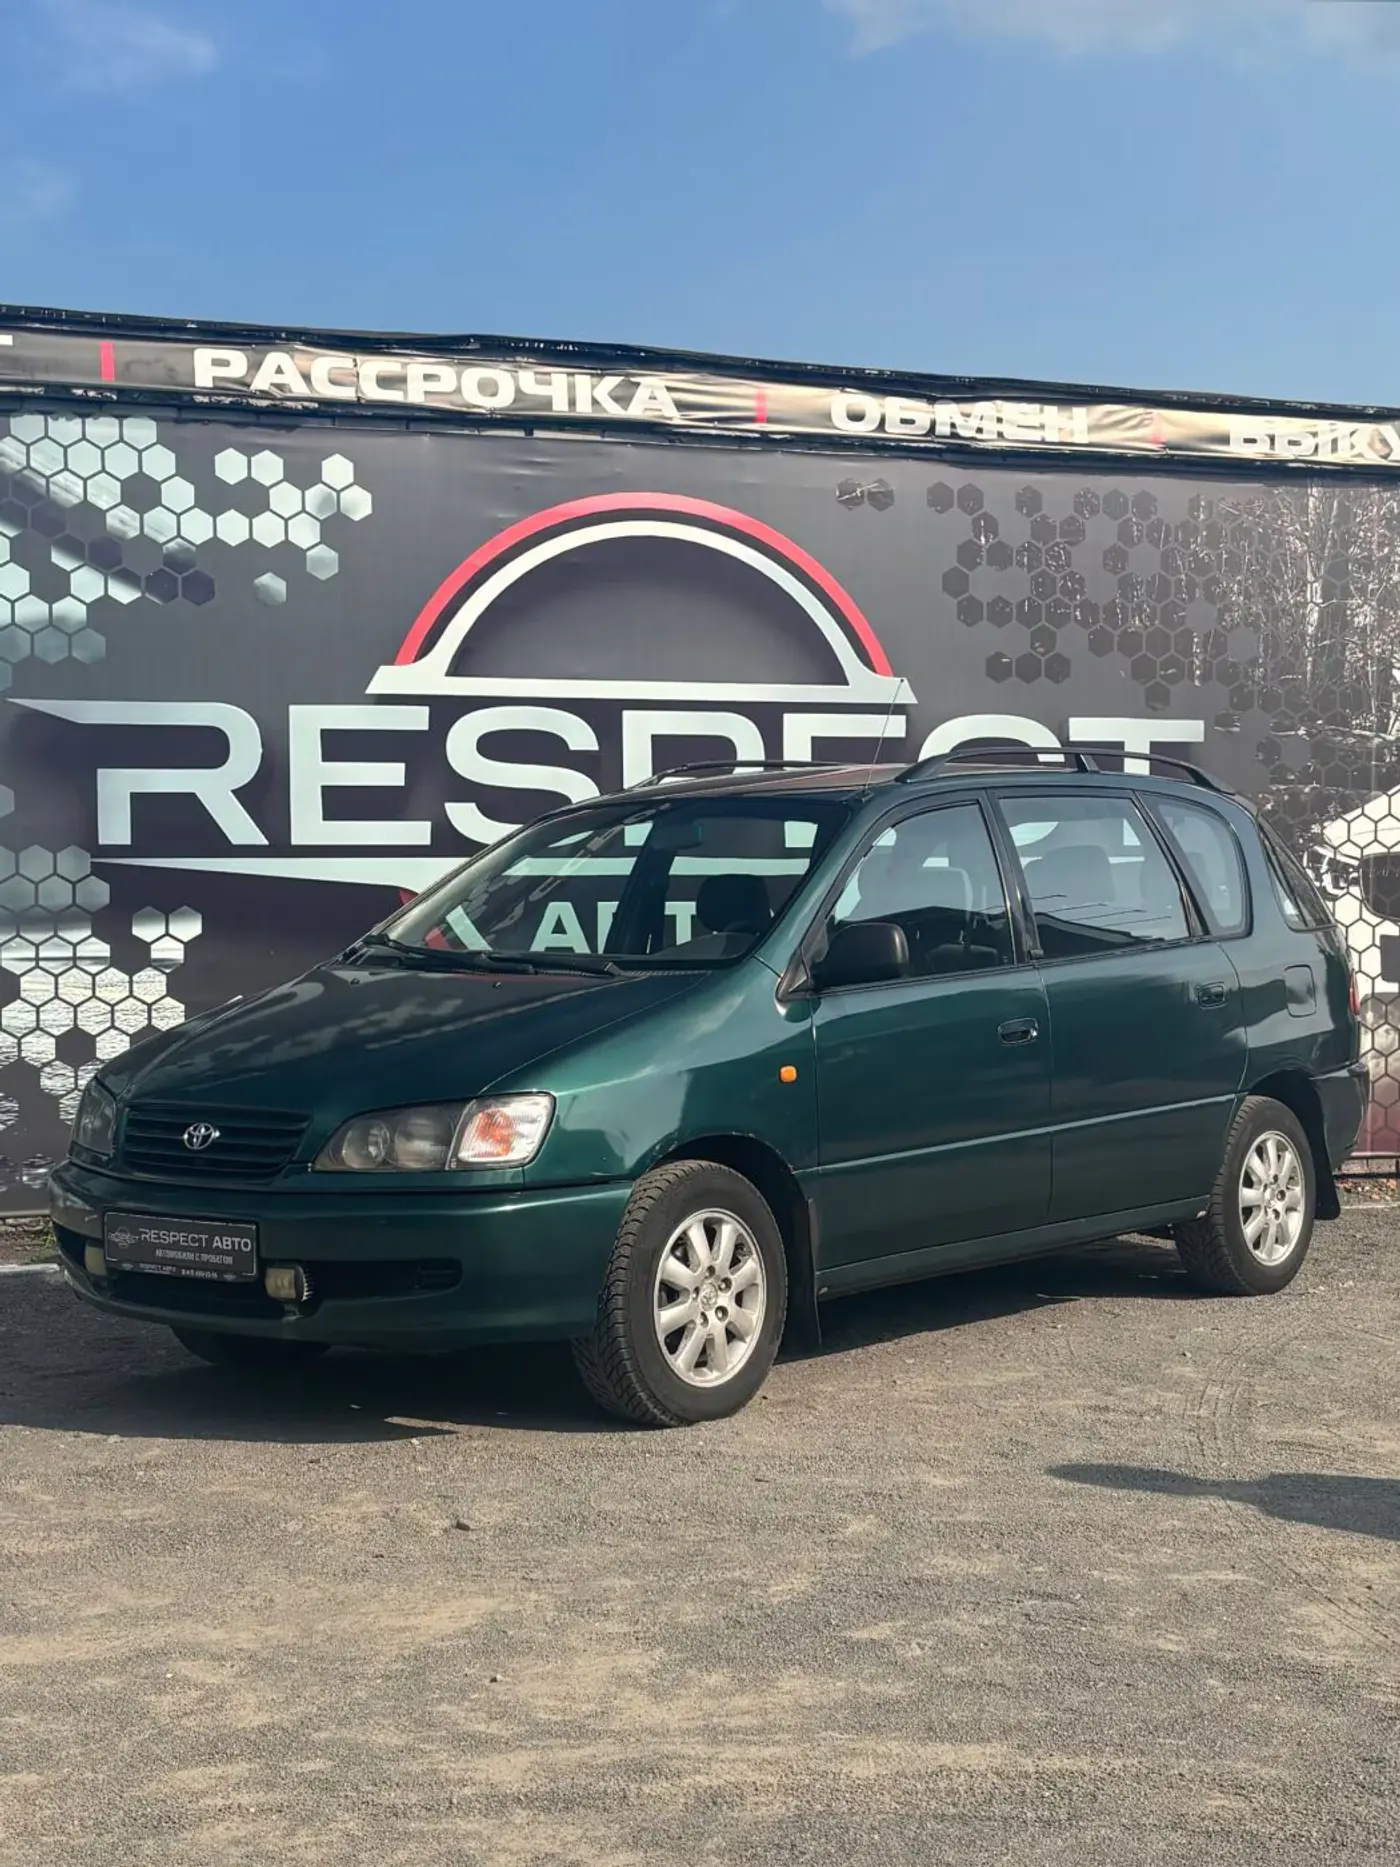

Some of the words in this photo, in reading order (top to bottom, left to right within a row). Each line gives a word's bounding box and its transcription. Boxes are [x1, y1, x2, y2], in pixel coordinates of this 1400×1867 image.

[193, 348, 680, 418] РАССРОЧКА
[830, 392, 1089, 443] ОБМЕН
[138, 1228, 208, 1247] RESPECT
[212, 1236, 252, 1252] АВТО
